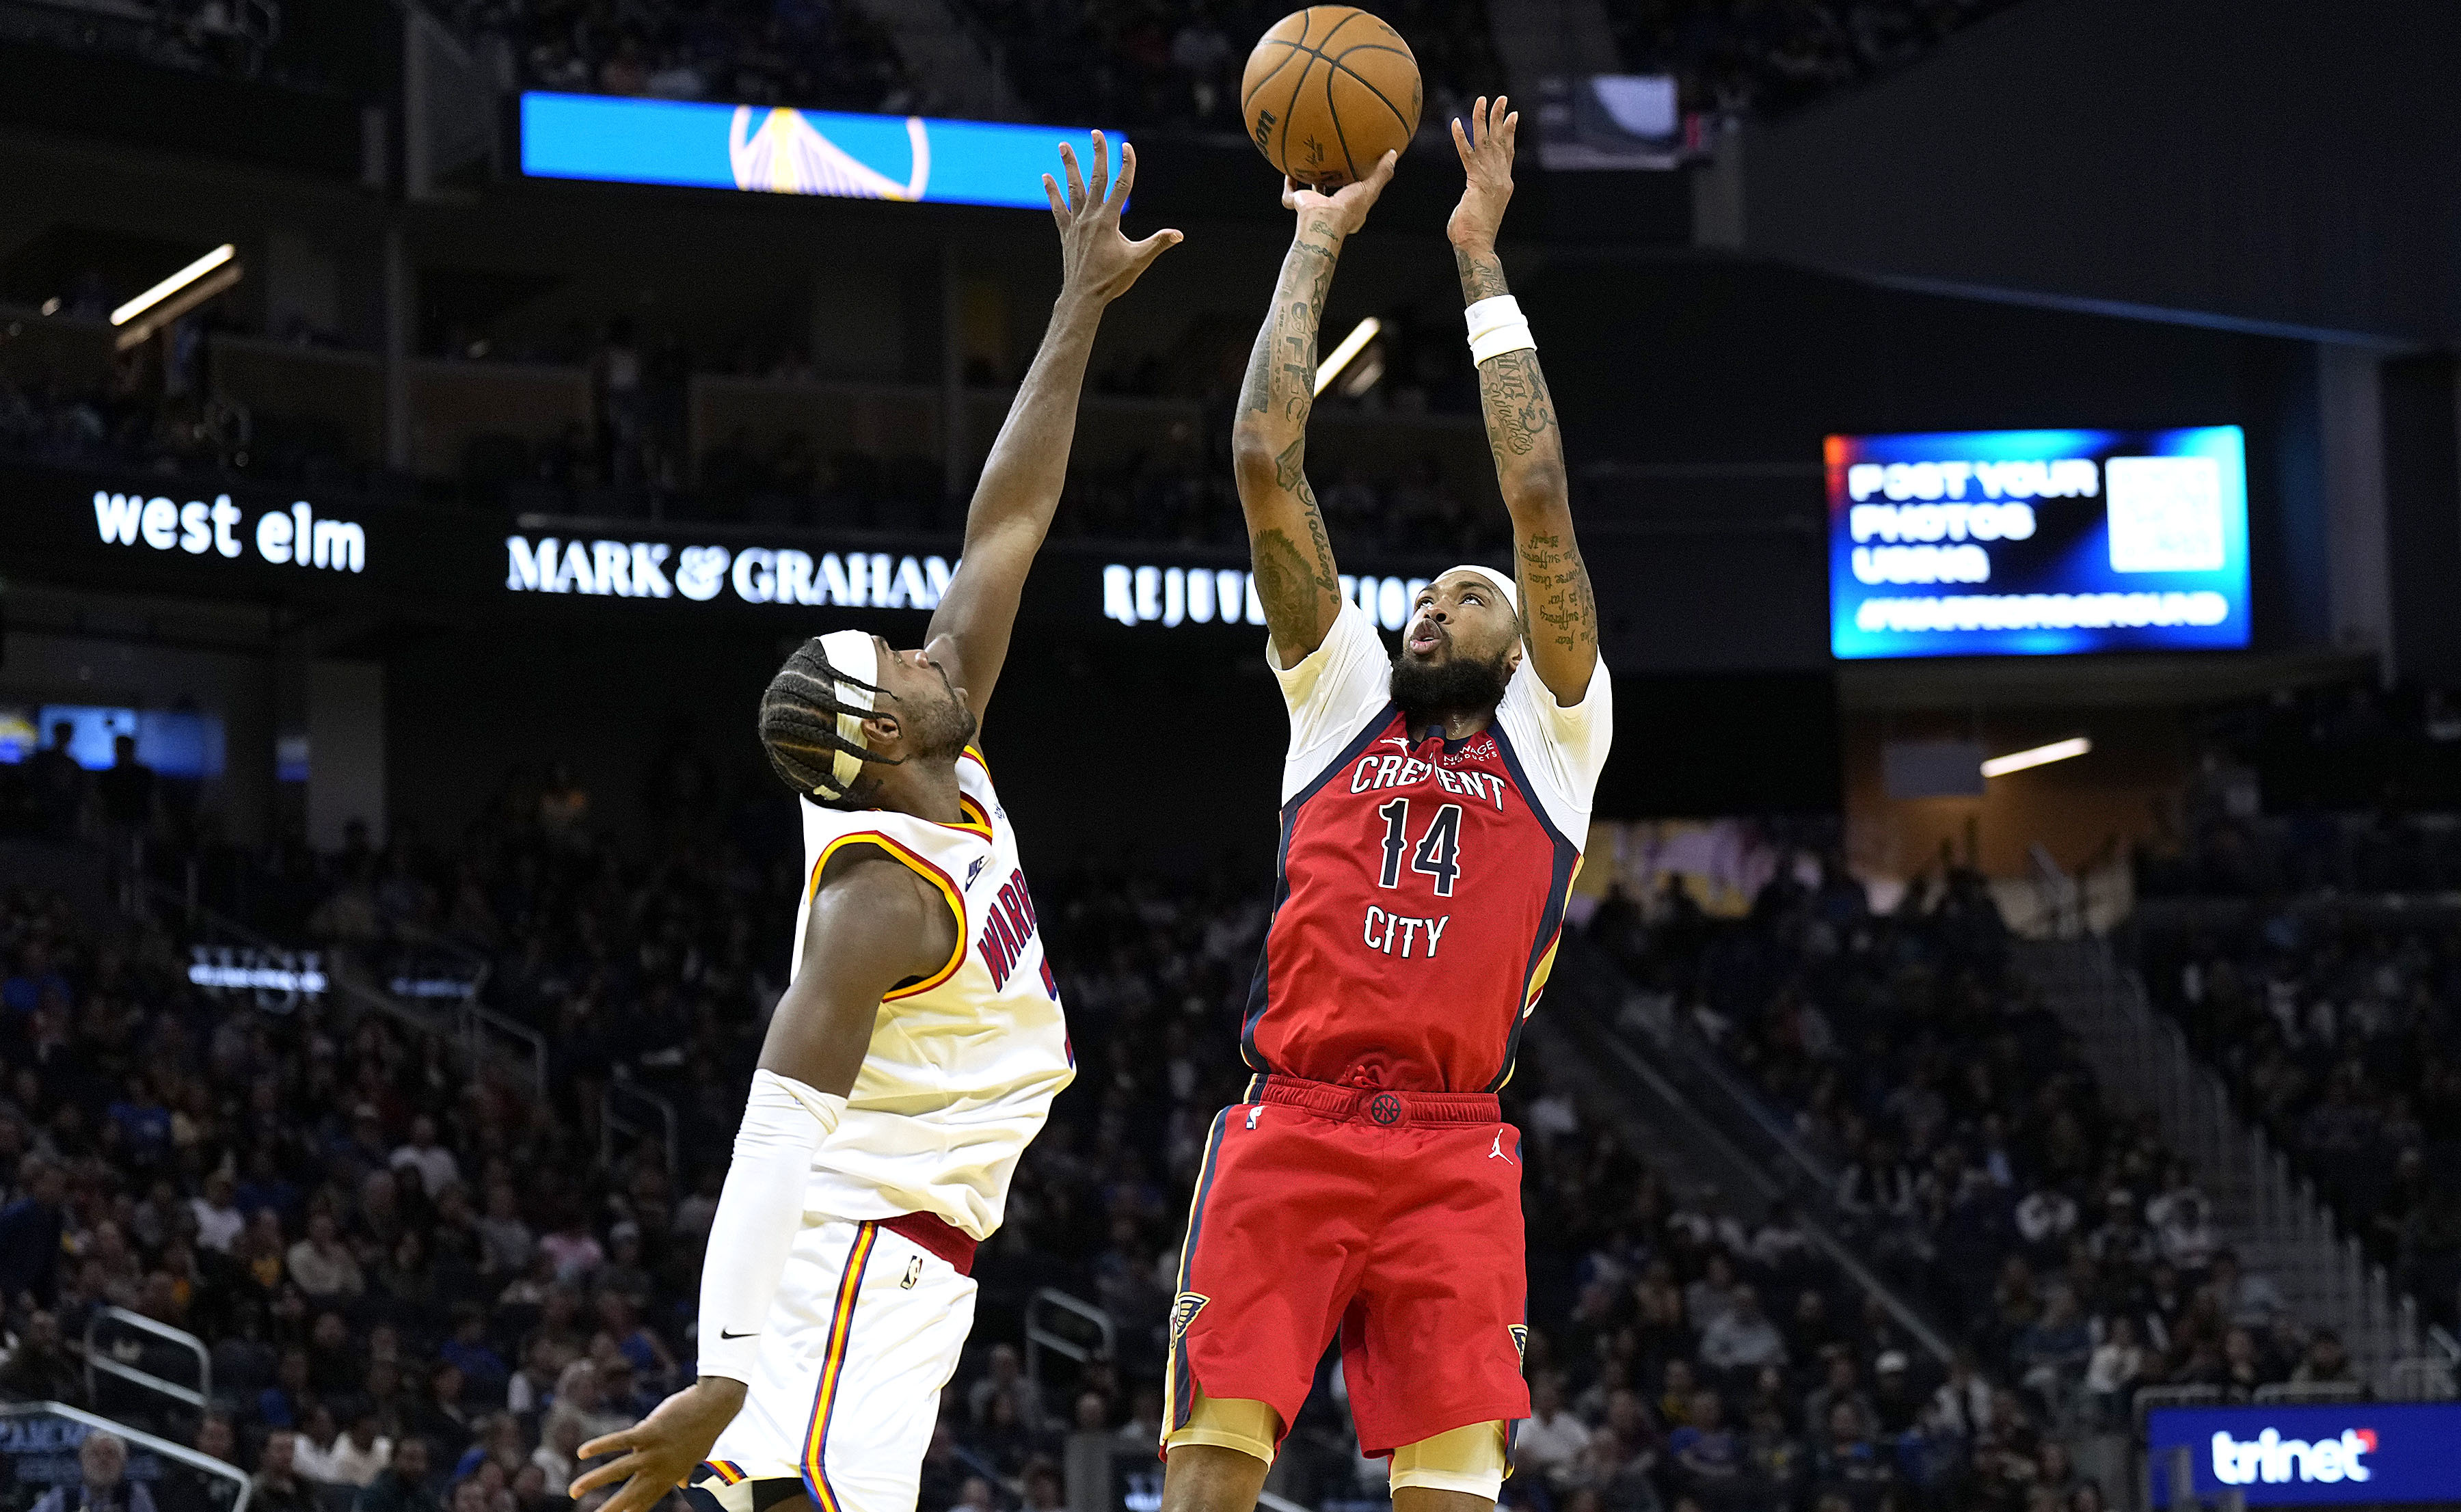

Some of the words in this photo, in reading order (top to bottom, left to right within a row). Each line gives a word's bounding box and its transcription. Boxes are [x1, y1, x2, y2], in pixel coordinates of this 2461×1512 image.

[1848, 461, 1971, 502] POST
[1974, 457, 2099, 500] YOUR
[93, 491, 242, 558] west
[256, 501, 366, 573] elm
[1850, 502, 2036, 544] PHOTOS
[506, 536, 673, 599] MARK
[676, 545, 731, 602] &
[1350, 754, 1506, 812] CREENT
[1378, 797, 1462, 897] 14
[1363, 905, 1450, 958] CITY
[2211, 1427, 2372, 1485] trinet
